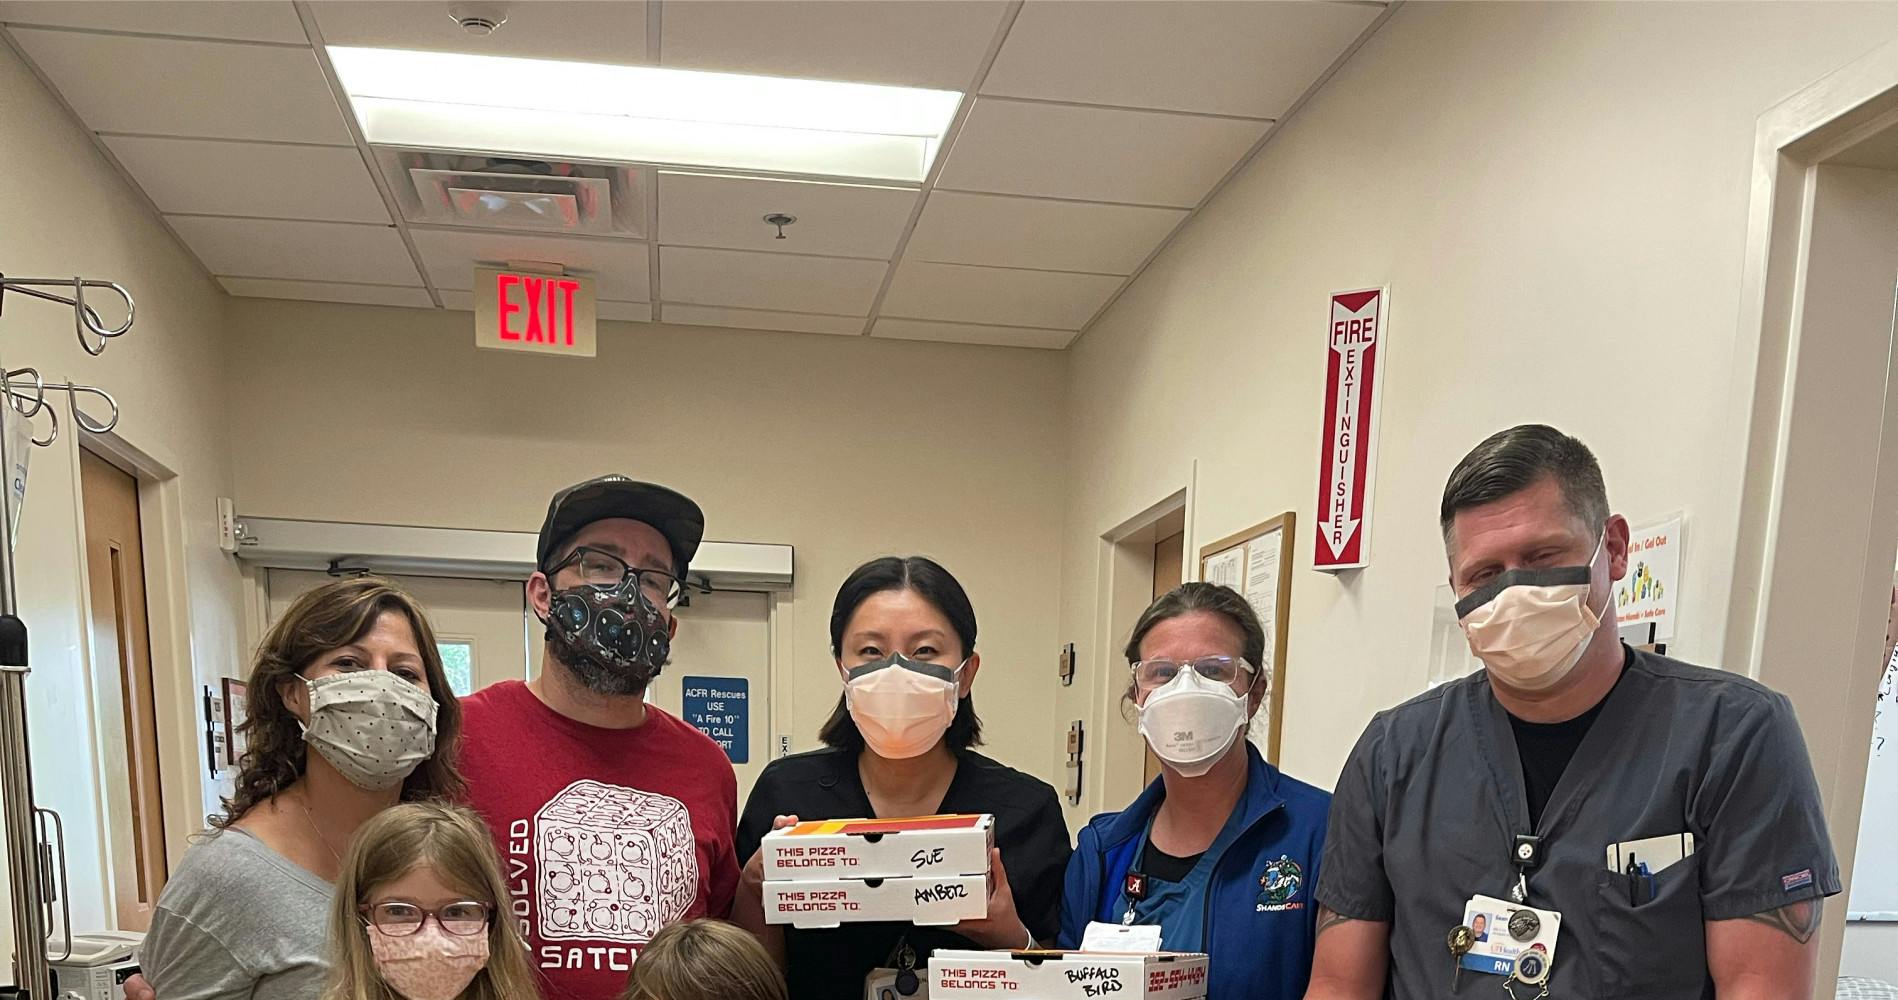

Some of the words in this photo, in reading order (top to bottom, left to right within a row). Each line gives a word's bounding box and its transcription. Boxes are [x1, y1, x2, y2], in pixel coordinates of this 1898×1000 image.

[498, 274, 580, 346] EXIT
[1333, 317, 1373, 346] FIRE
[1333, 349, 1355, 545] EXTINGUISHER
[685, 689, 708, 698] ACFR
[711, 689, 746, 700] Rescues
[707, 702, 725, 711] USE
[706, 714, 721, 724] Fire
[712, 727, 734, 737] CALL
[1173, 731, 1193, 741] 3M
[776, 848, 803, 857] THIS
[809, 847, 845, 856] PIZZA
[777, 858, 835, 868] BELONGS
[911, 848, 944, 868] SUE
[509, 819, 531, 950] SOLVED
[778, 892, 804, 901] THIS
[810, 892, 846, 900] PIZZA
[914, 884, 968, 905] AMBER
[778, 903, 836, 912] BELONGS
[1494, 961, 1511, 972] RN
[941, 968, 967, 978] THIS
[971, 970, 1006, 979] PIZZA
[1065, 967, 1118, 983] BUFFALO
[941, 979, 996, 989] BELONGS
[1083, 980, 1122, 997] BIRD
